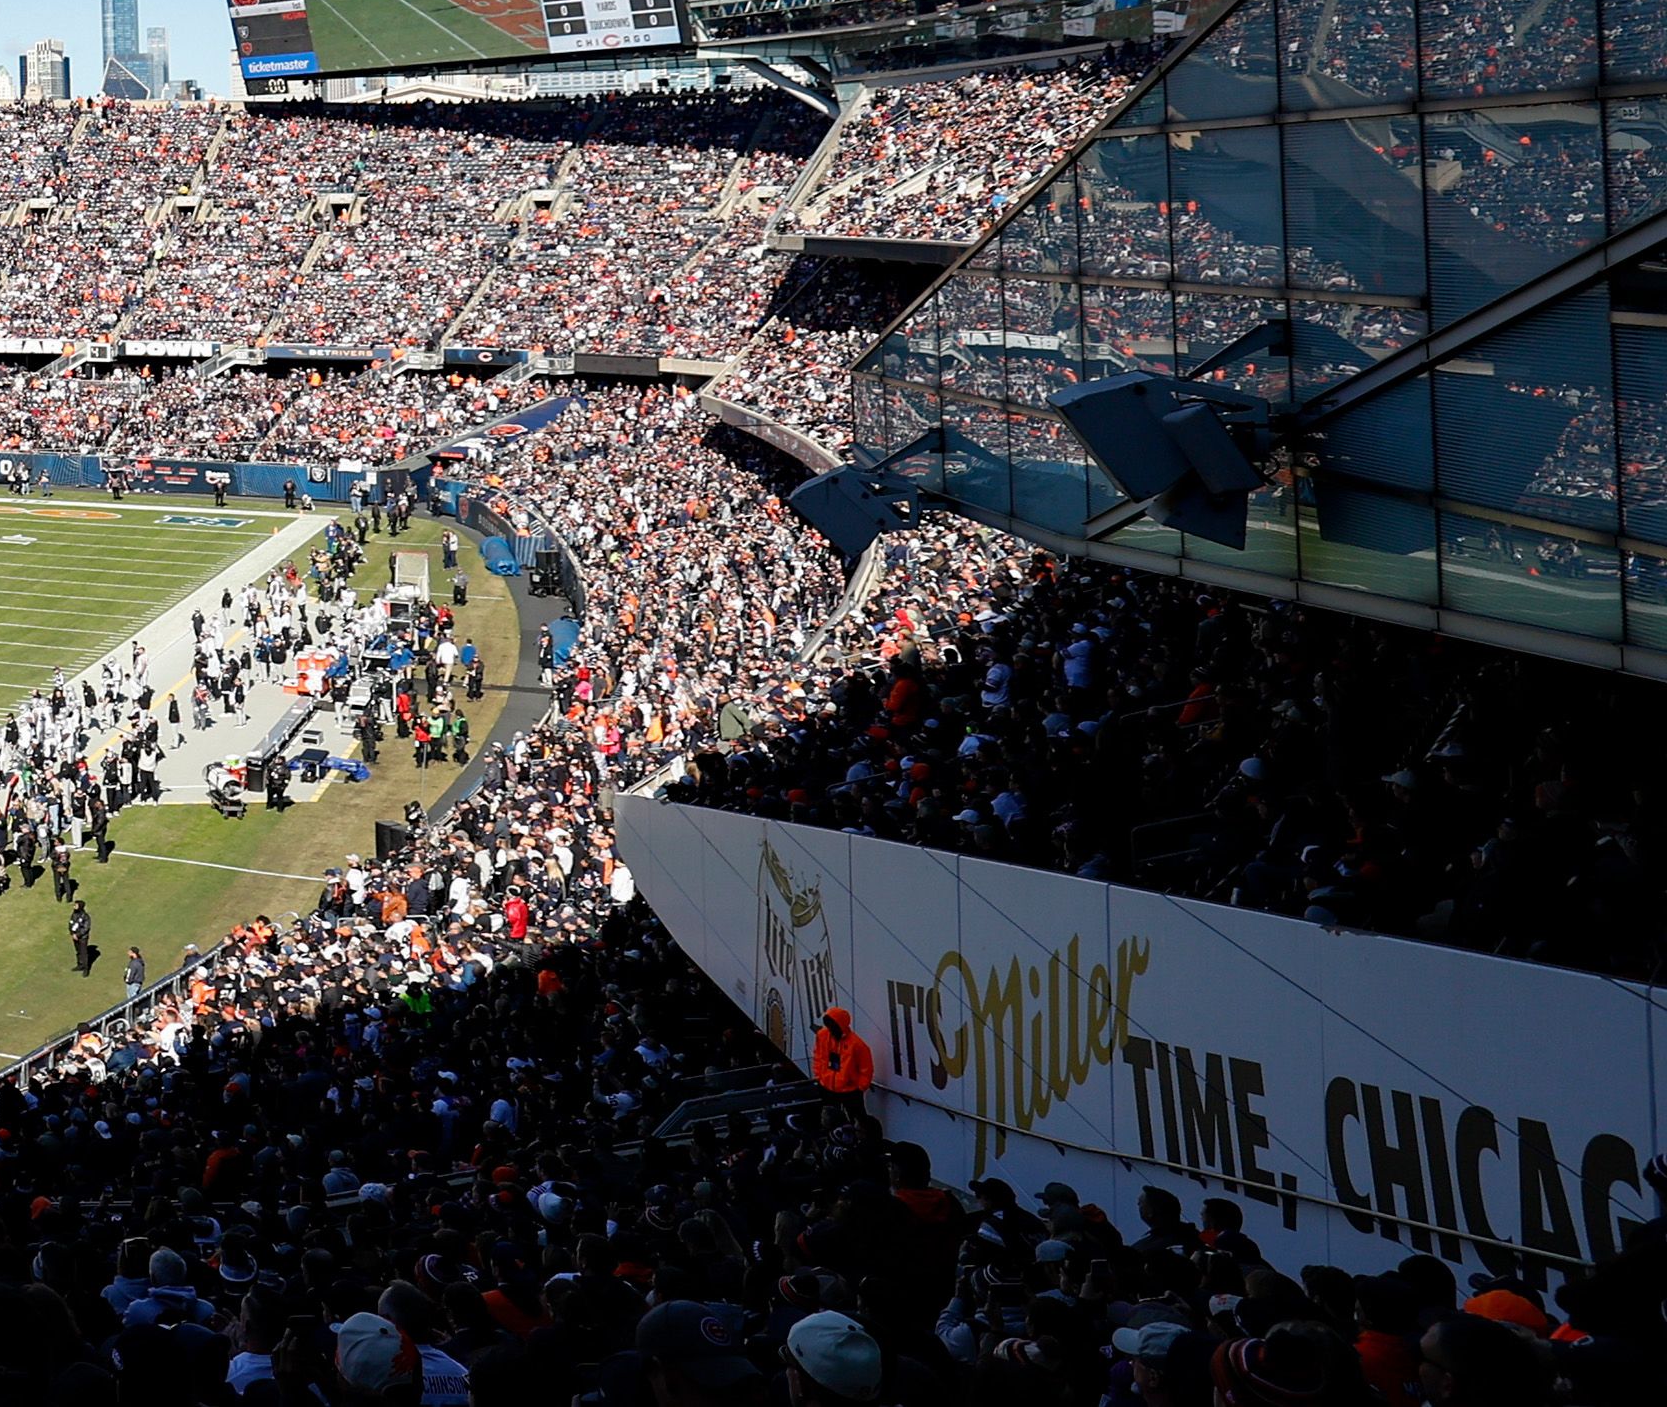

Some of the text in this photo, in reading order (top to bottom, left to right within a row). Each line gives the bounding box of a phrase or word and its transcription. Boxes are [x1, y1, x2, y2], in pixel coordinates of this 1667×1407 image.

[560, 5, 568, 15] 0
[596, 0, 616, 12] YARDS
[563, 14, 658, 33] 0 TOUCHDOWNS 0
[248, 60, 309, 74] ticketmaster
[125, 342, 213, 356] DOWN
[308, 349, 374, 357] BETRIVERS
[886, 979, 949, 1090] IT'S
[931, 933, 1149, 1182] Miller
[1123, 1035, 1298, 1231] TIME,
